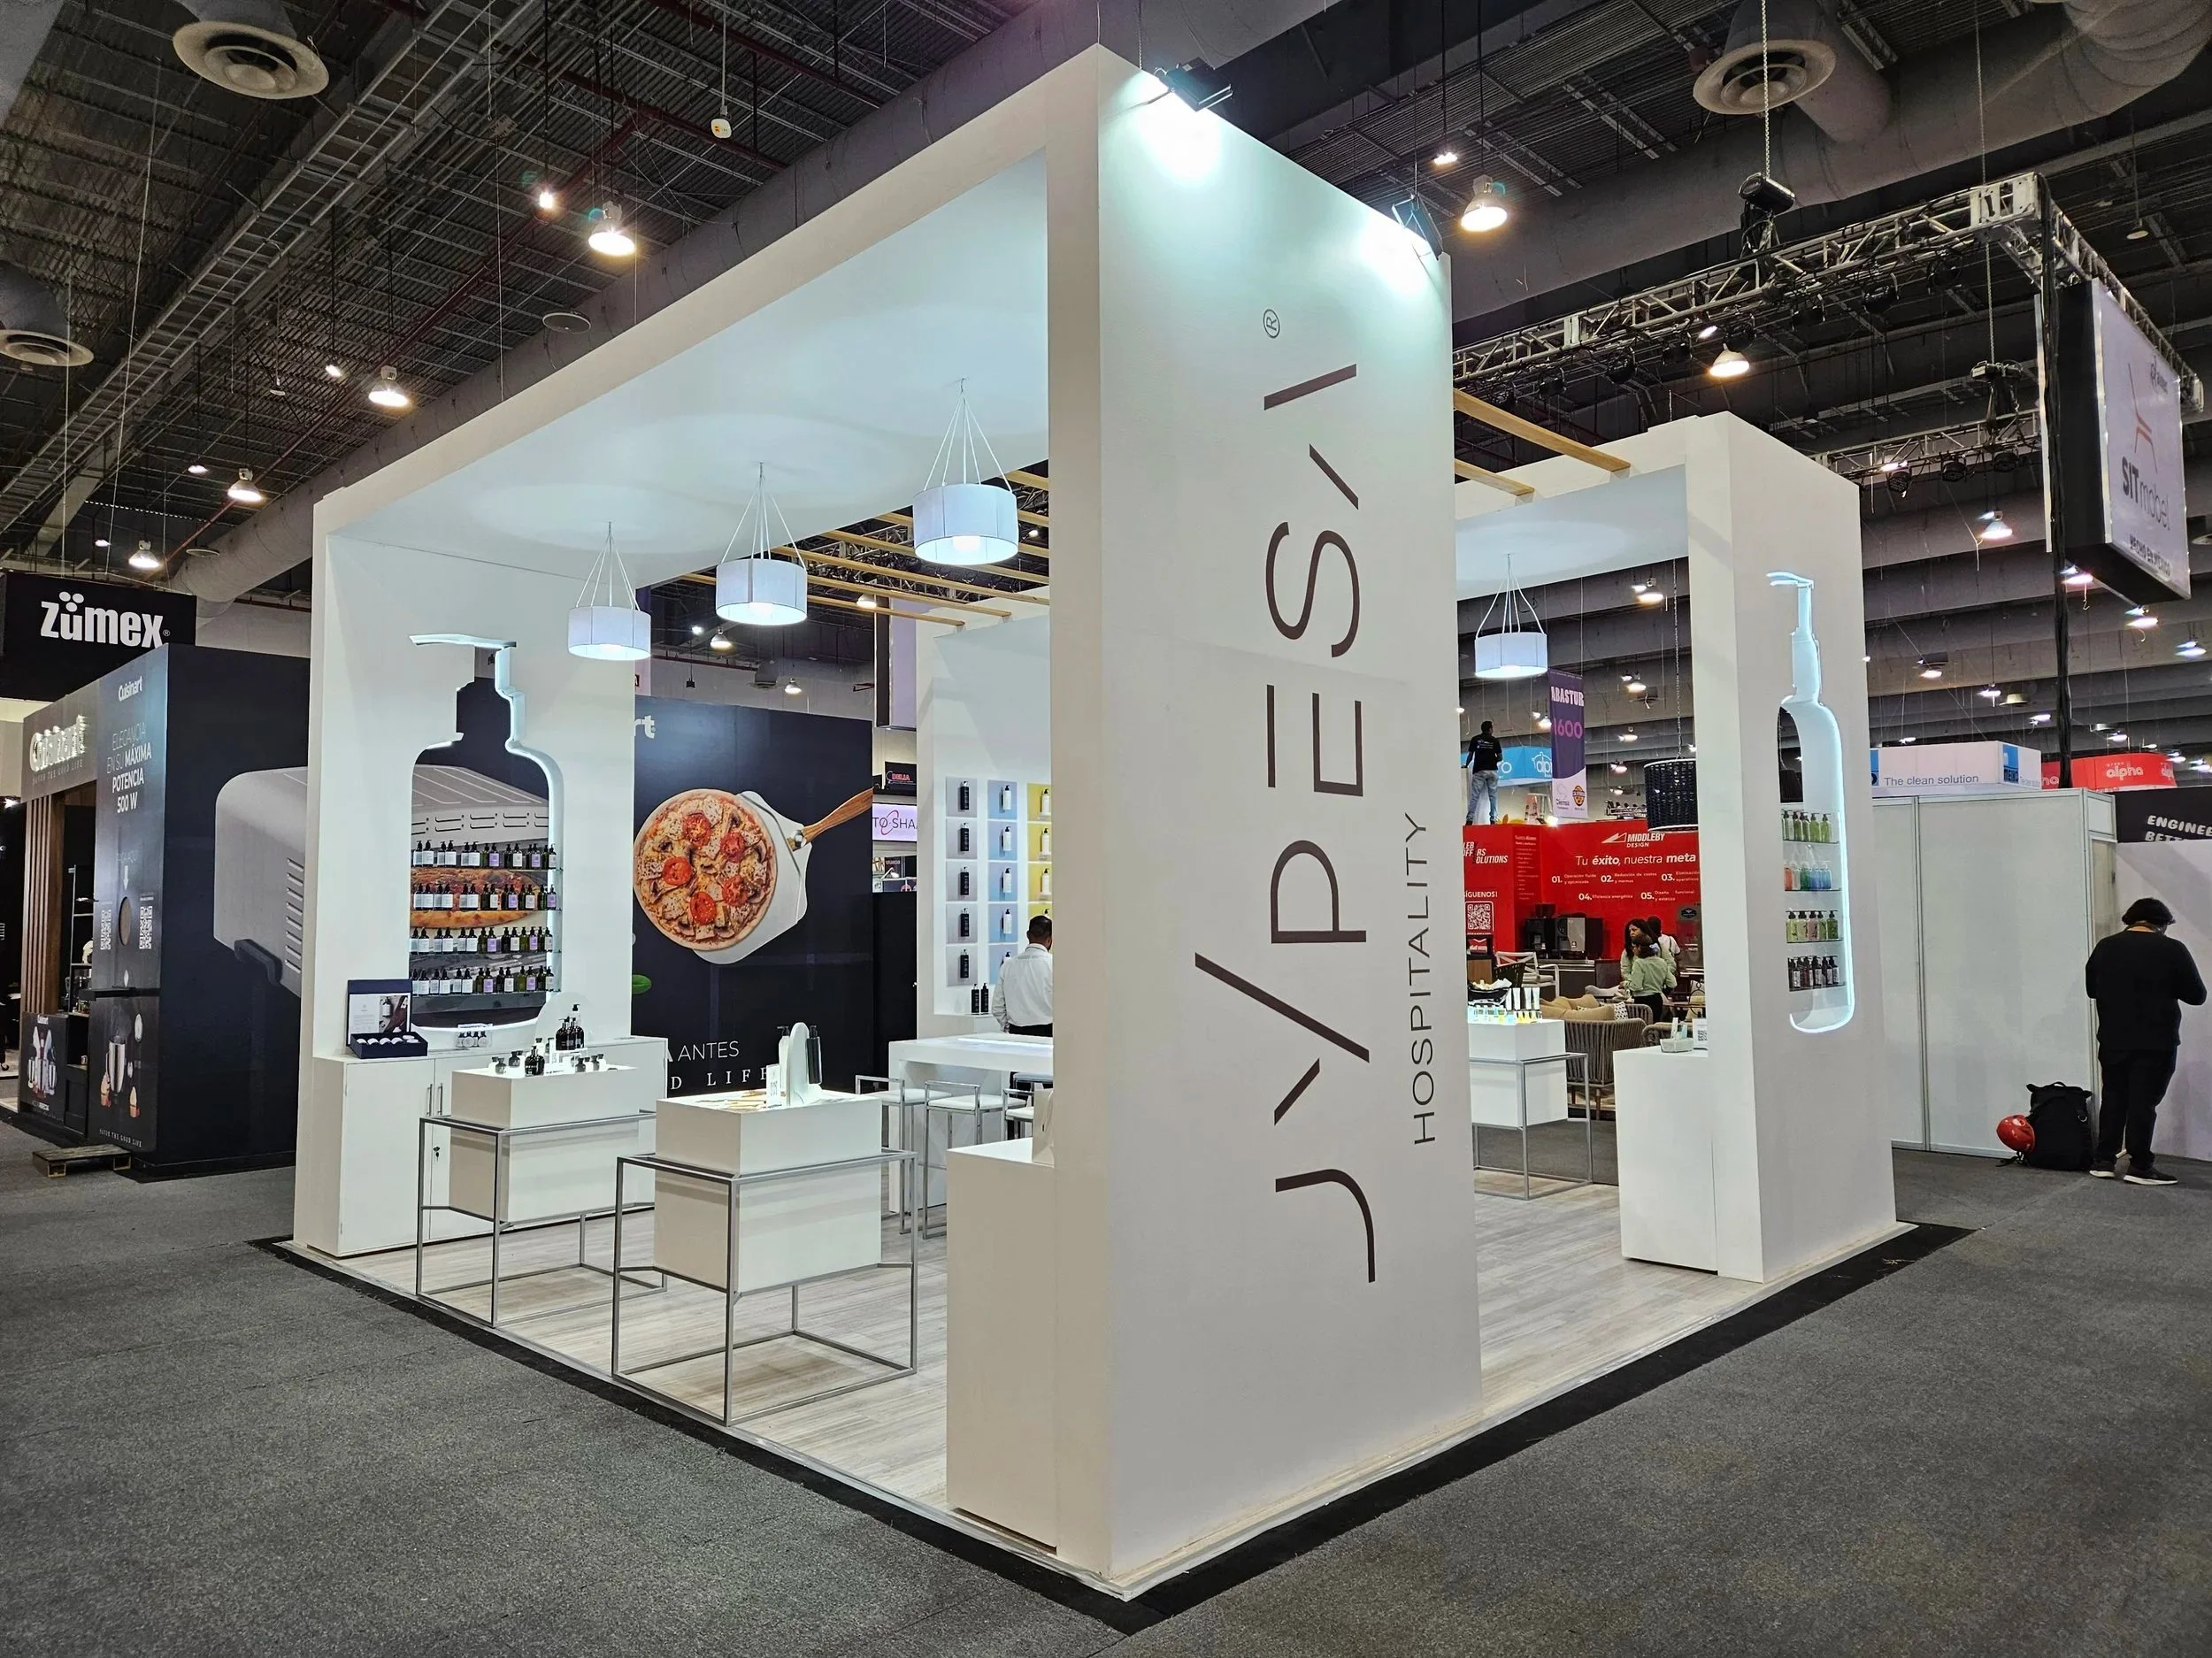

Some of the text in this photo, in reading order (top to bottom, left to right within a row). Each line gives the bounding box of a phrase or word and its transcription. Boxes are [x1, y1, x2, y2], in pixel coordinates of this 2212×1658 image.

[1550, 686, 1585, 707] ABASTUR
[112, 722, 146, 751] ELEGANCIA
[1554, 718, 1583, 740] 1600
[125, 741, 152, 768] MÁXIMA
[112, 767, 145, 794] POTENCIA
[1883, 777, 1904, 787] The
[1907, 776, 1935, 786] clean
[1938, 774, 1979, 785] solution
[2106, 764, 2144, 781] alpha
[117, 791, 138, 813] 500 W
[1627, 833, 1665, 842] MIDDLEBY
[1476, 855, 1509, 864] OLUTIONS
[1575, 852, 1696, 867] Tu éxito, nuestra meta
[1551, 875, 1563, 884] 01.
[1600, 874, 1615, 883] 02.
[1640, 891, 1655, 900] 05.
[1405, 812, 1436, 1145] HOSPITALITY
[678, 1040, 740, 1062] ANTES
